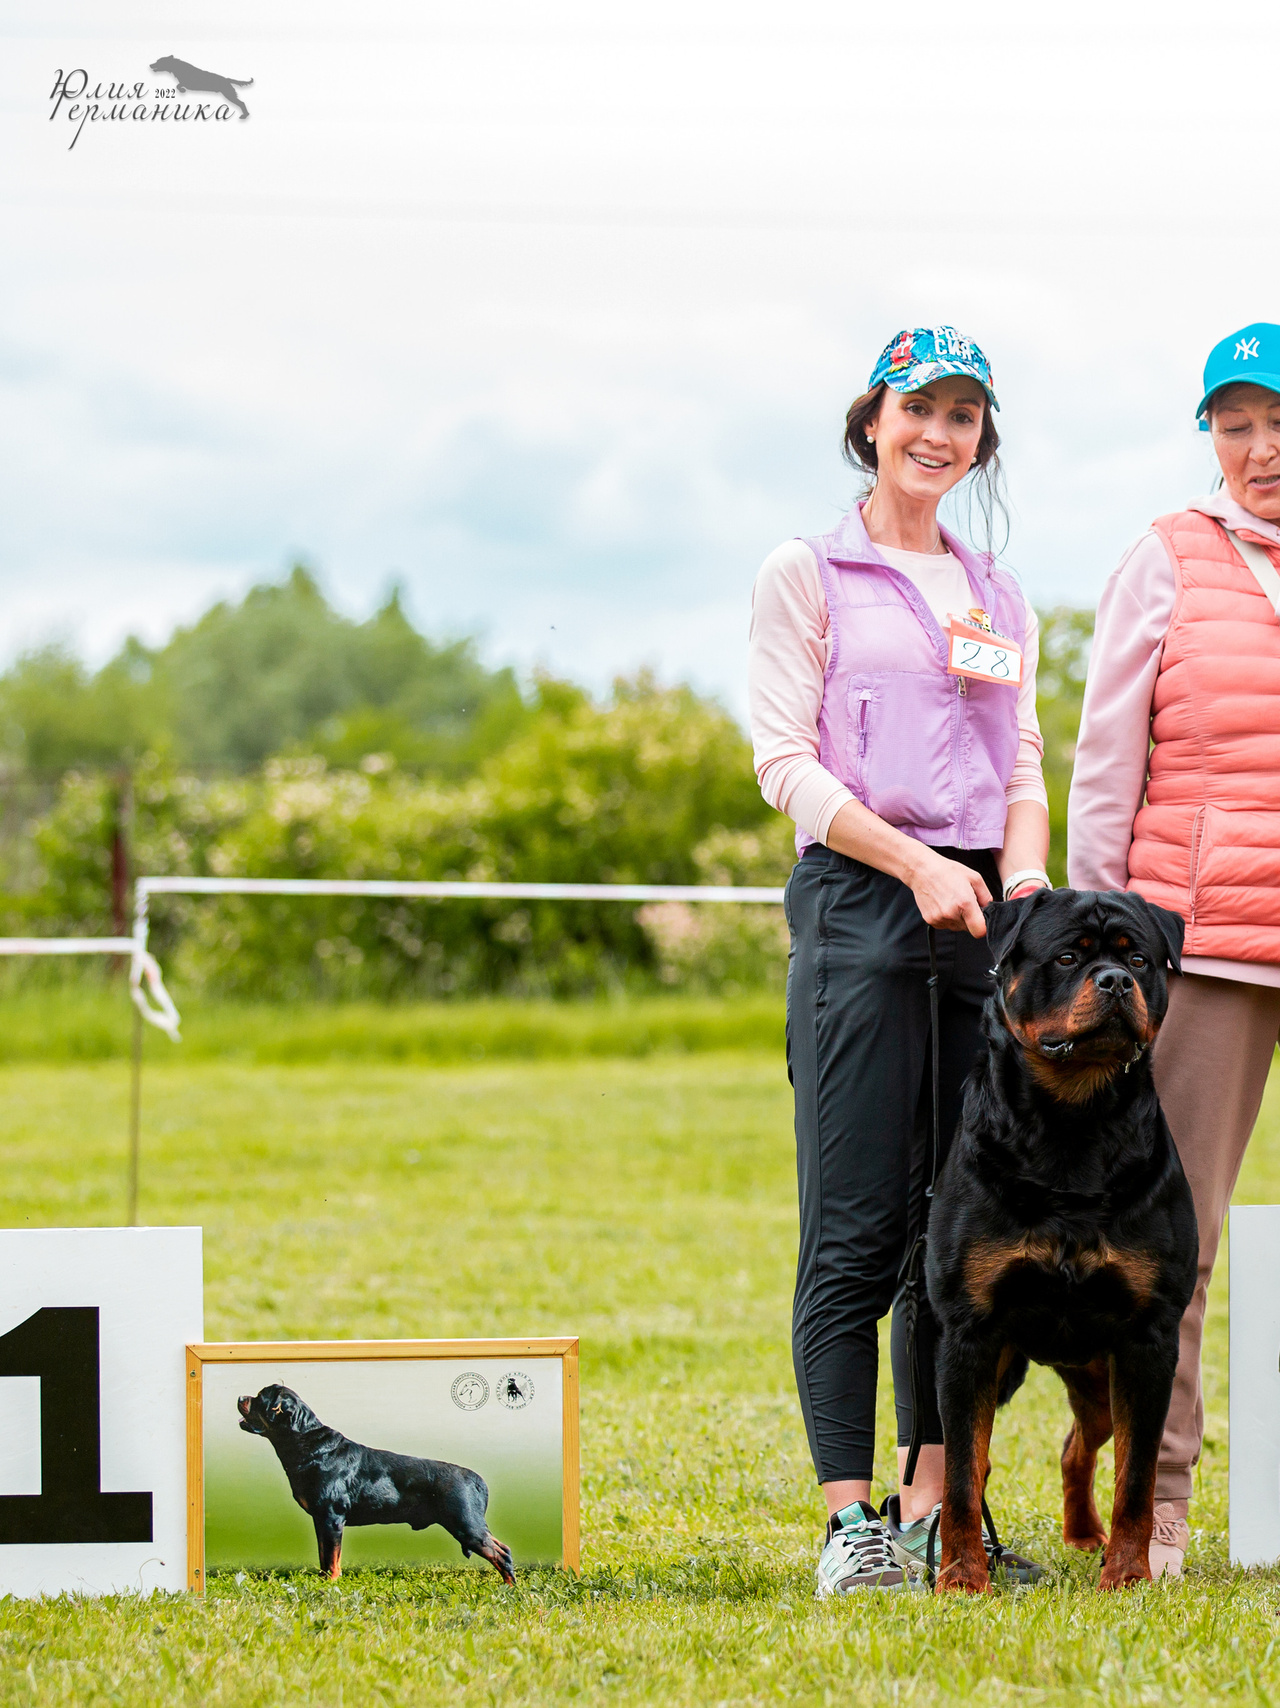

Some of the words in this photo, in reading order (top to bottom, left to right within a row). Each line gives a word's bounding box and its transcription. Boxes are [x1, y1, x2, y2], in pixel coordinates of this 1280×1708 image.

[934, 338, 972, 361] СИЯ
[1233, 336, 1261, 361] NY
[960, 641, 1010, 678] 28
[0, 1306, 153, 1544] 1
